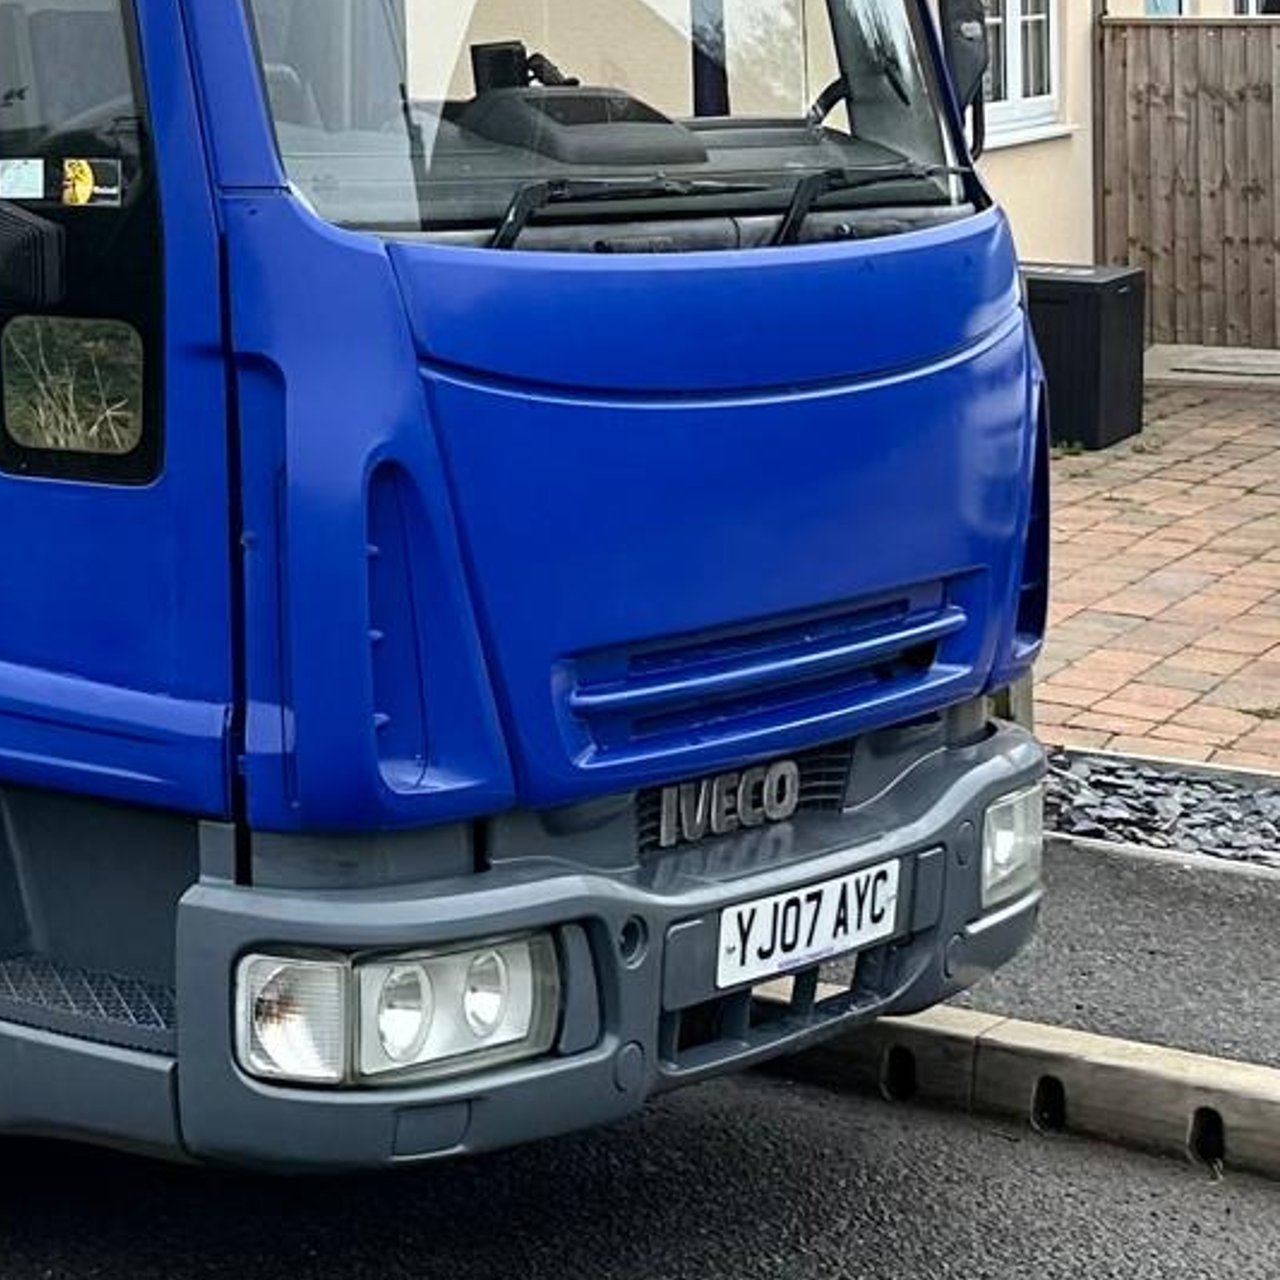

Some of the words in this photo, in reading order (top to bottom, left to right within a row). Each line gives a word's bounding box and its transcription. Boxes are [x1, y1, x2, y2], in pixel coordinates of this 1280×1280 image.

[660, 760, 799, 847] IVECO
[737, 890, 823, 967] YJ07
[832, 870, 888, 939] AYC
